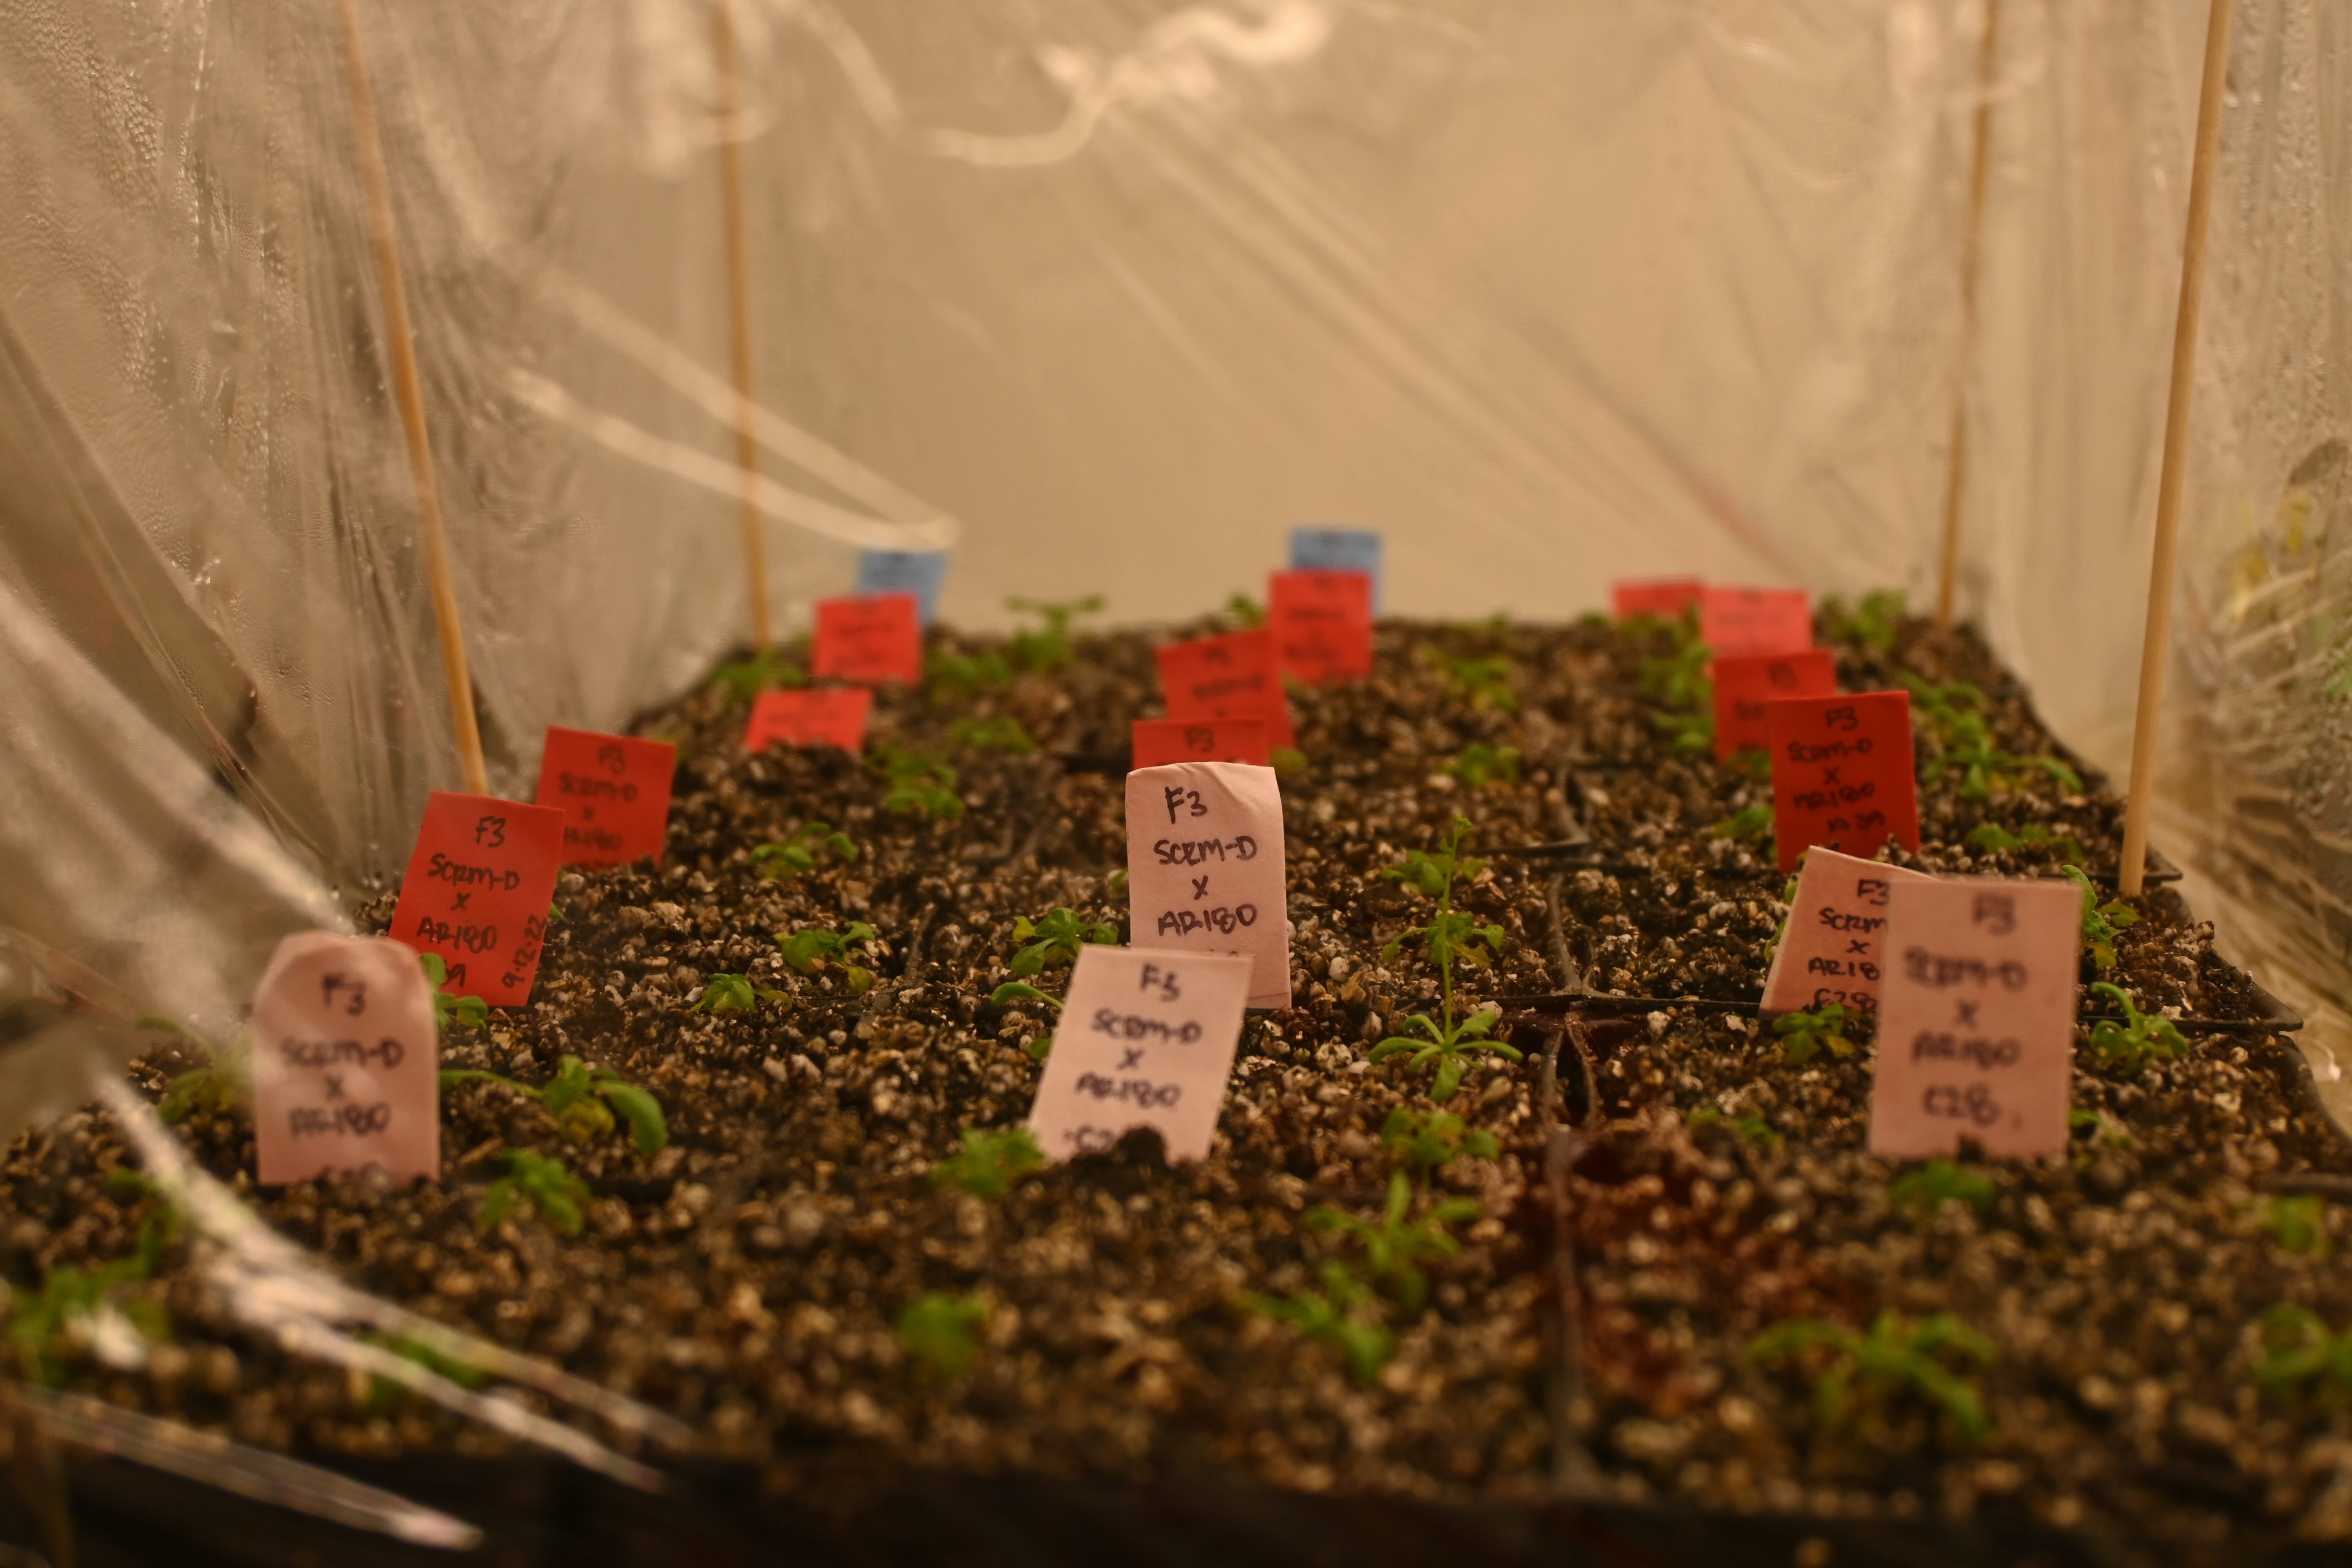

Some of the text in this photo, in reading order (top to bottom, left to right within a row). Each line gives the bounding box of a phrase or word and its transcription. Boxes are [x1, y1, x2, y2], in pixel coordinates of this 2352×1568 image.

[1825, 706, 1859, 731] F3
[1165, 787, 1208, 825] F3
[475, 816, 506, 848] F3
[1153, 835, 1258, 866] SCRM-D
[427, 853, 520, 890] SCRM-D
[1857, 879, 1889, 905] F3
[1157, 903, 1257, 937] AR180
[1819, 907, 1887, 933] SCRM
[1974, 892, 2016, 936] F3
[416, 916, 497, 954] AR180
[1141, 963, 1181, 1003] F3
[1808, 957, 1881, 981] AR18
[321, 974, 367, 1016] F3
